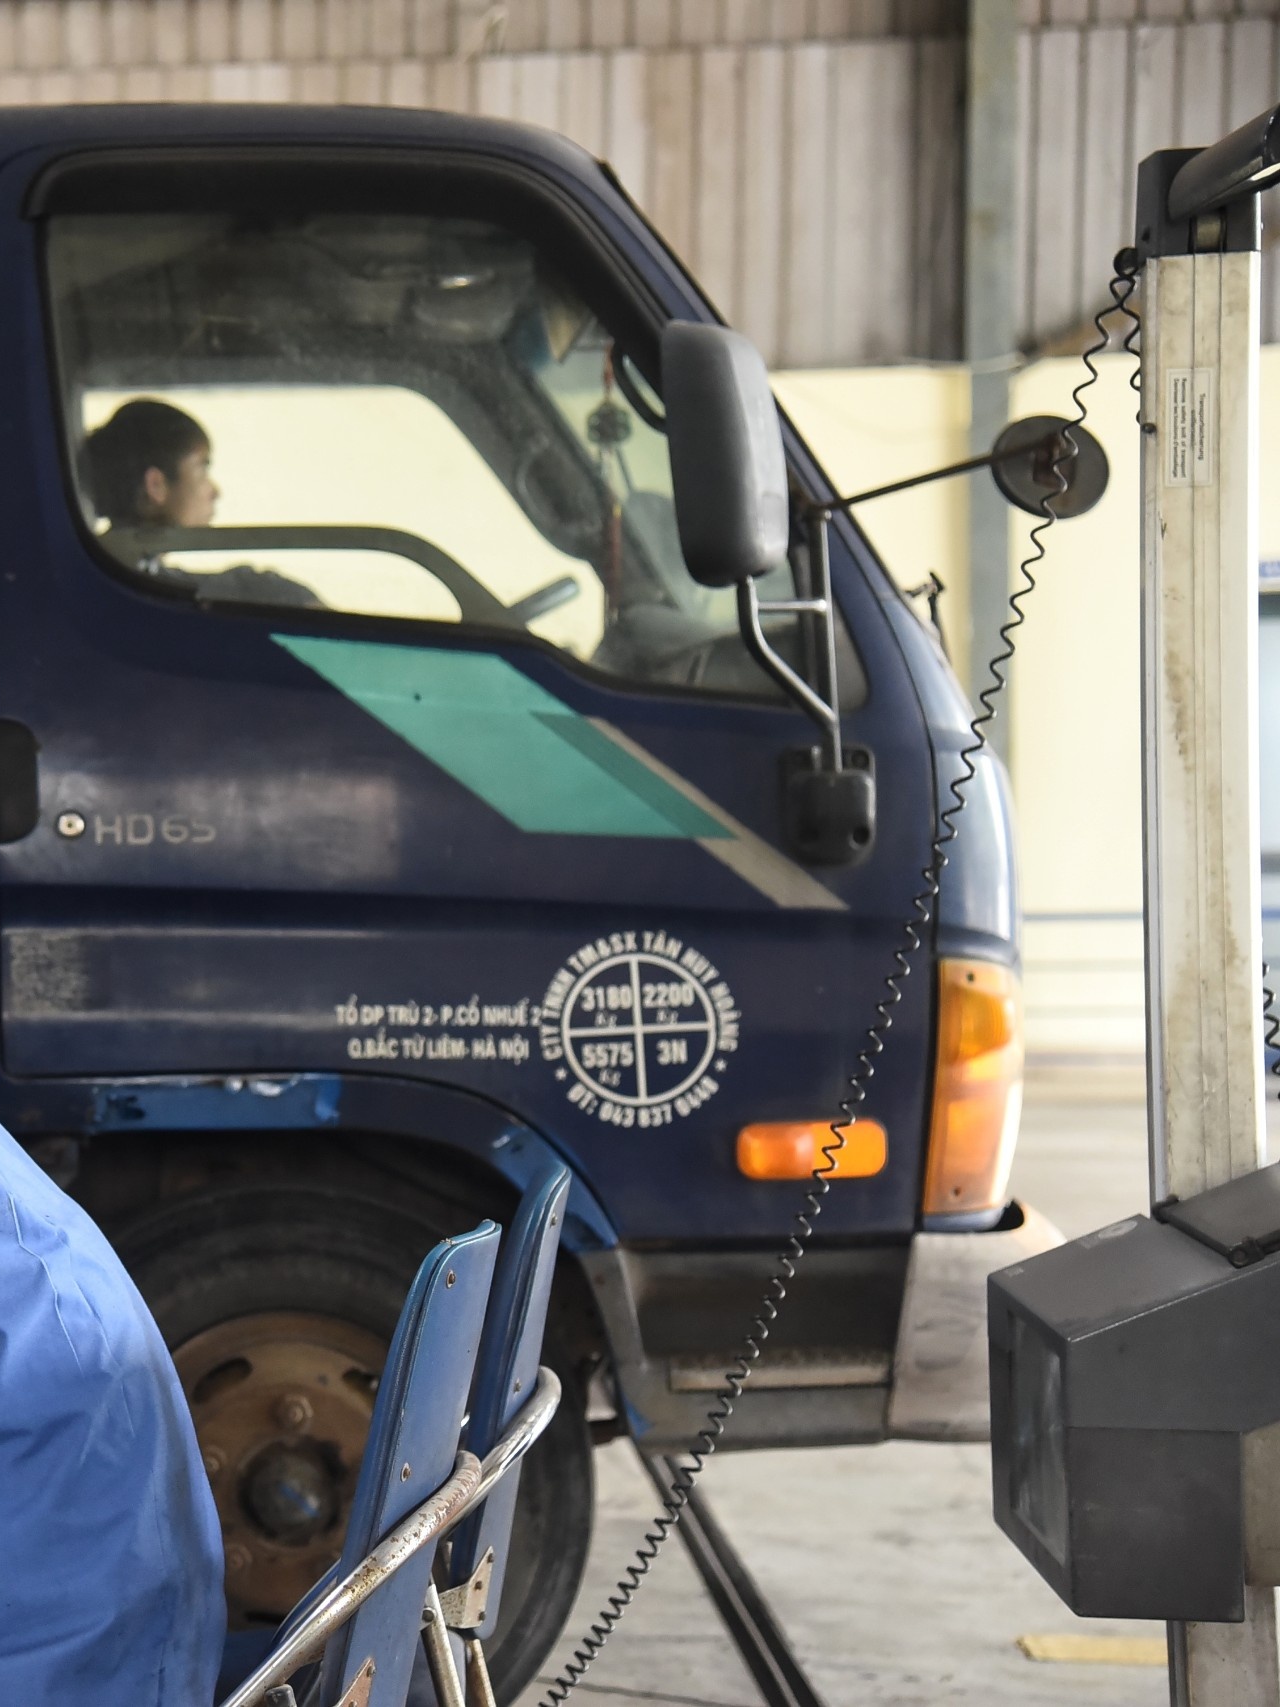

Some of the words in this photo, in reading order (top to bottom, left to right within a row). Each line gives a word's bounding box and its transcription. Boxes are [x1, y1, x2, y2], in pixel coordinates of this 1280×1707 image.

[581, 984, 634, 1012] 3180
[642, 982, 696, 1008] 2200
[471, 1033, 497, 1060] HÀ
[498, 1033, 530, 1066] NỘI
[581, 1042, 635, 1069] 5575
[656, 1038, 689, 1066] 3N
